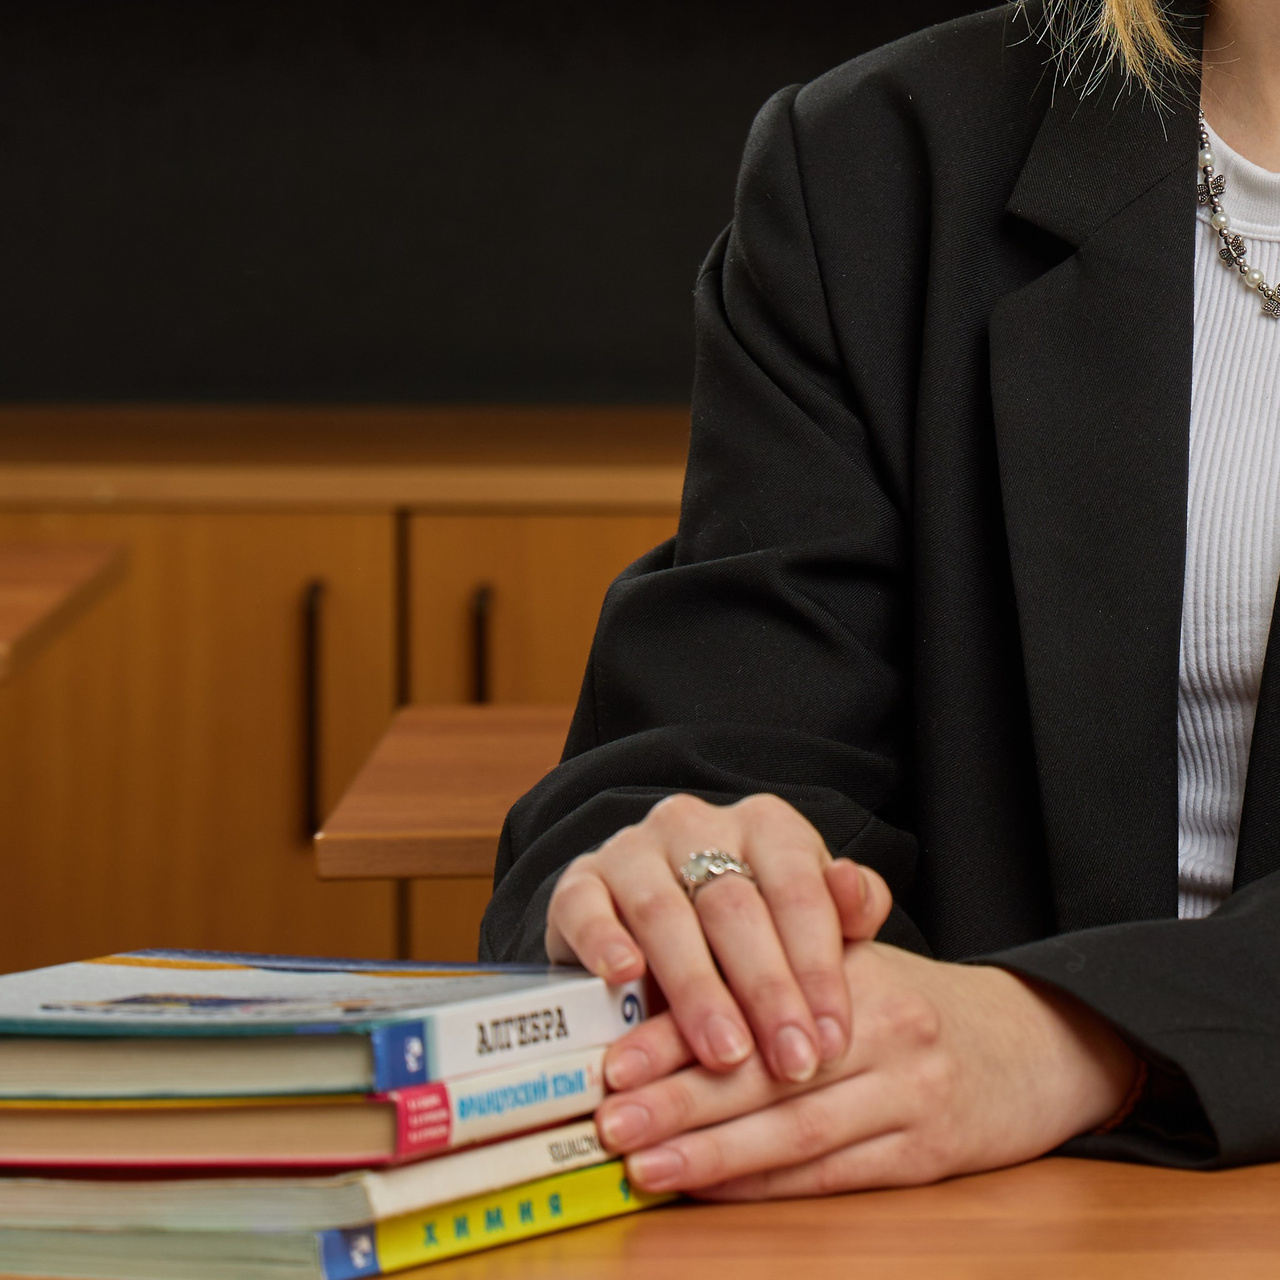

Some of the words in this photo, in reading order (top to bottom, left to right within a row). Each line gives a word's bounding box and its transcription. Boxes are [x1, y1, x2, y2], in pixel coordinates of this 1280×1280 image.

[476, 1006, 569, 1054] АЛГЕБРА
[622, 993, 643, 1024] 9
[458, 1074, 549, 1119] ФРАНЦУЗСКИЙ
[424, 1193, 562, 1246] ХИМИЯ
